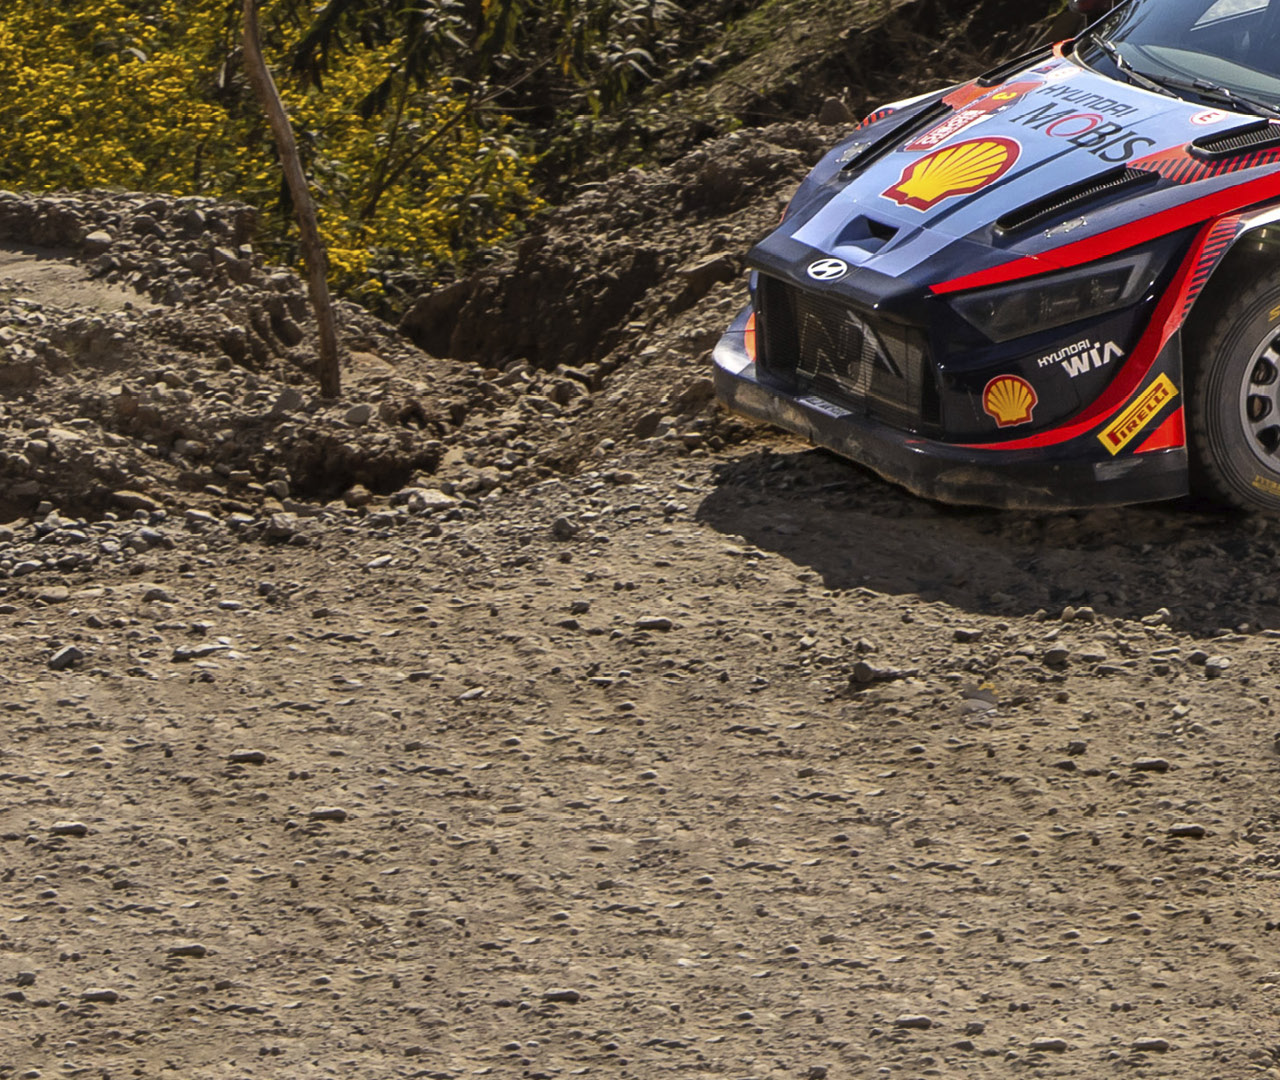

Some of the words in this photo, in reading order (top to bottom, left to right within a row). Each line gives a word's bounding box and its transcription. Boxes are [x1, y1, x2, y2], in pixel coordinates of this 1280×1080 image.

[1039, 83, 1139, 118] HYUNDAI
[1009, 103, 1156, 163] MOBIS
[1037, 339, 1091, 368] HYUNDAI
[1106, 382, 1169, 447] PIRELLI
